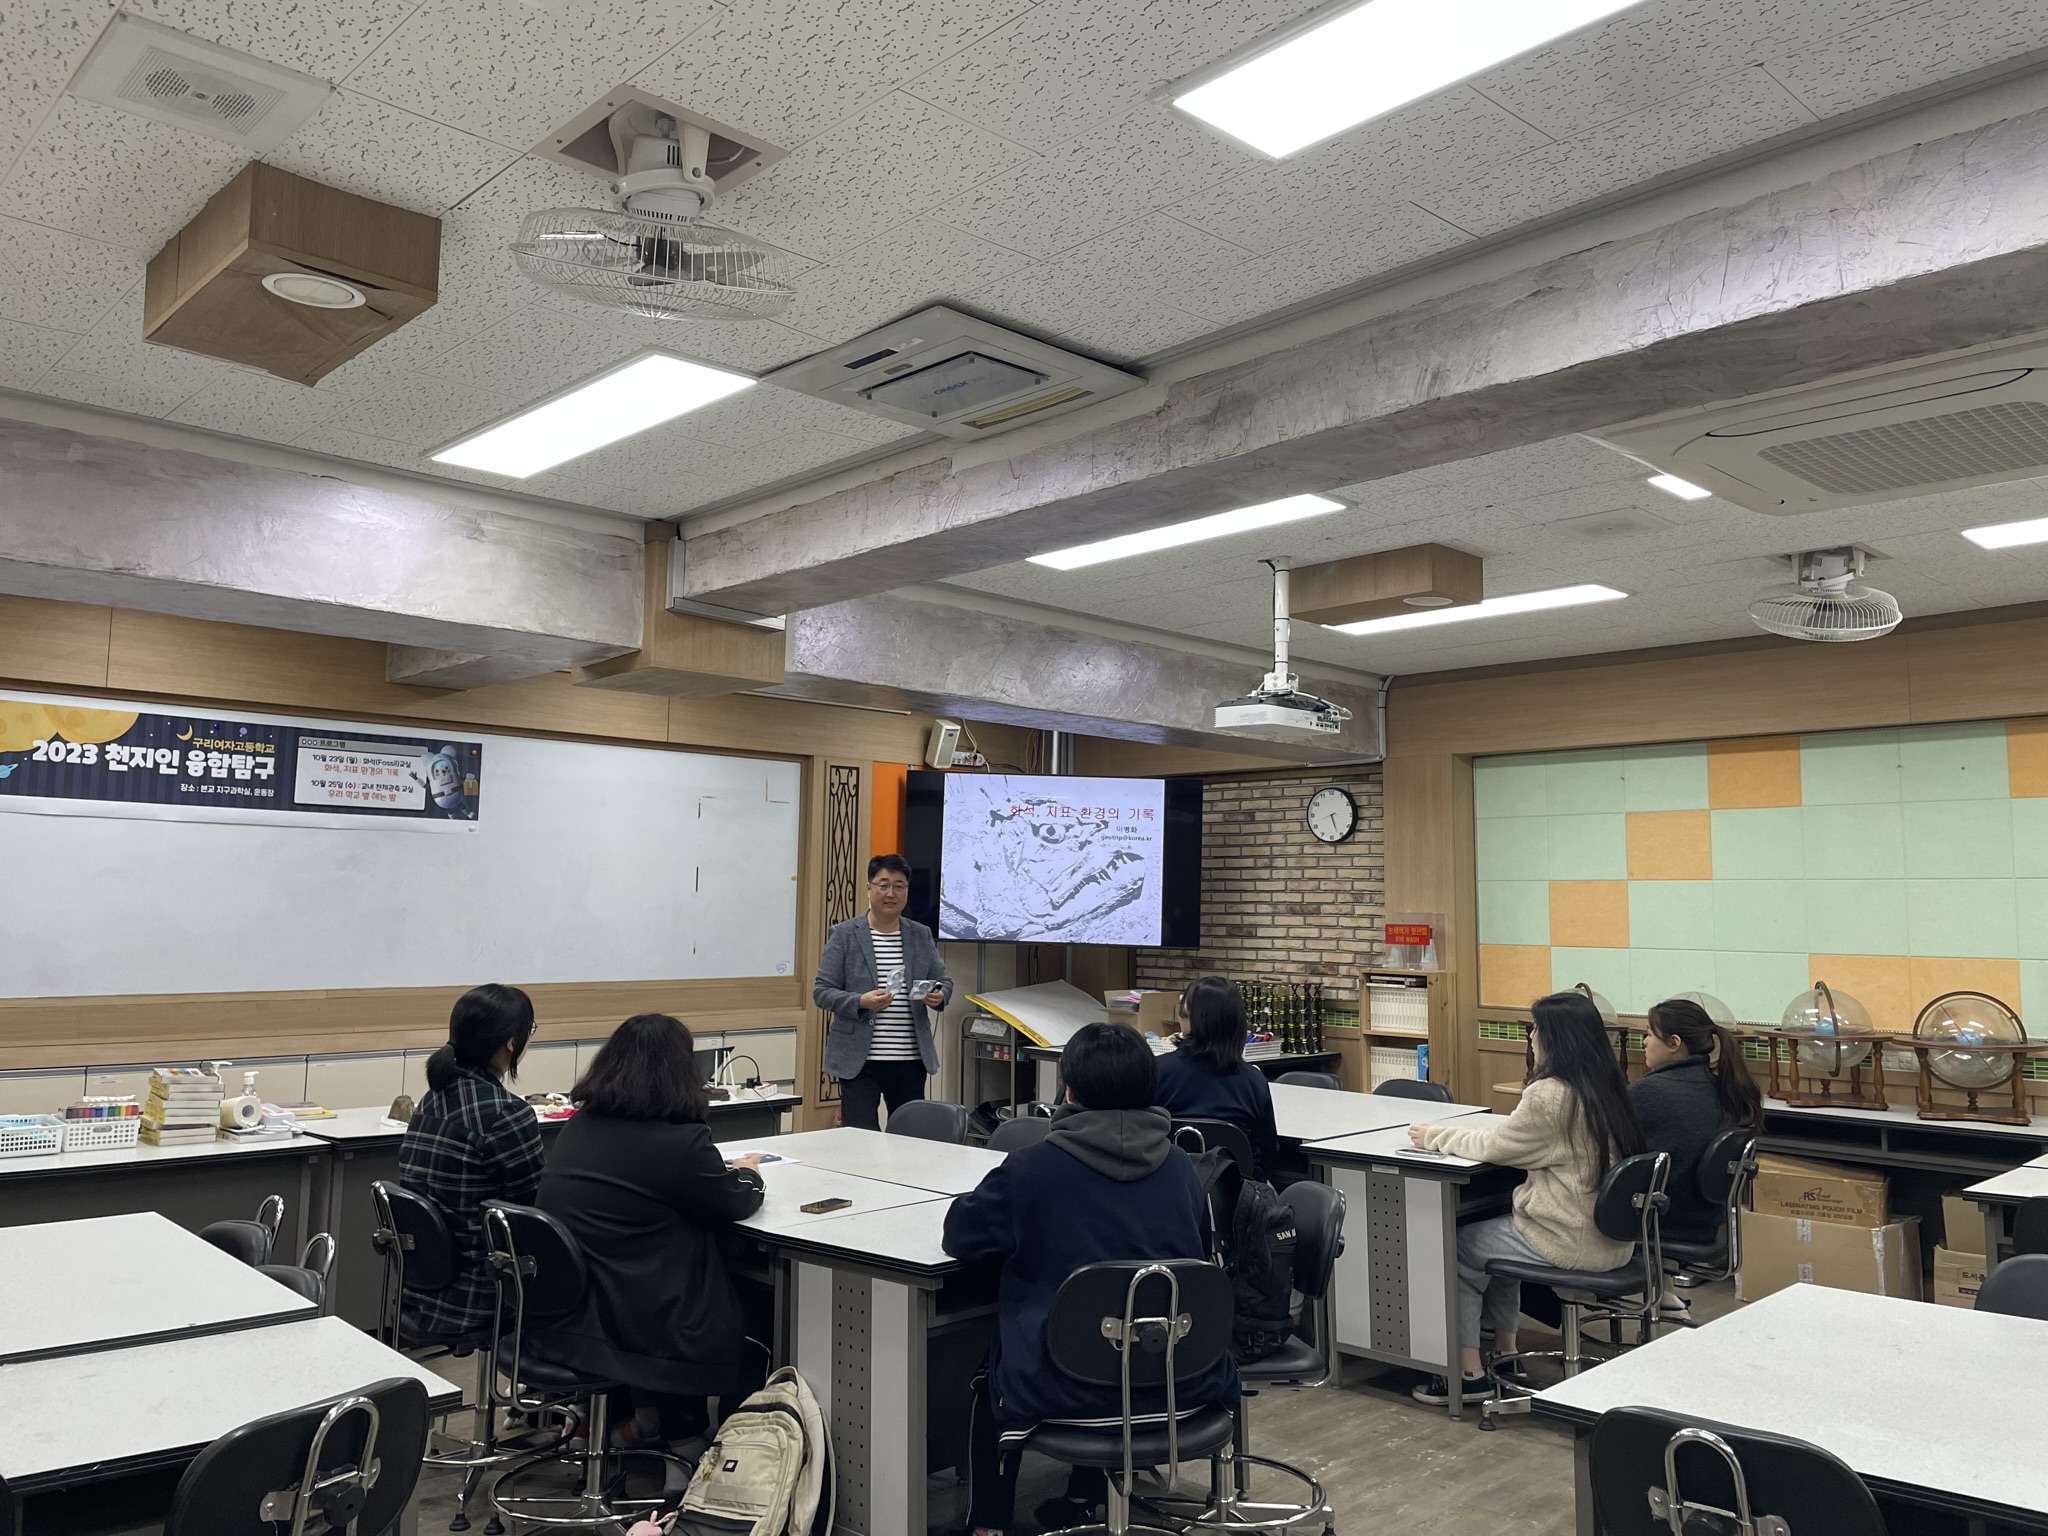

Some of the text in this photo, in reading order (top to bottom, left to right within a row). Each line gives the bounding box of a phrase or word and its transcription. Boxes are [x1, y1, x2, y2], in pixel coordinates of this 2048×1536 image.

[192, 737, 275, 754] 구리여자고등학교
[320, 740, 346, 748] 프로그램
[32, 740, 276, 780] 2023 천지인 융합탐구
[329, 755, 344, 764] 23일
[324, 764, 342, 773] 화석,
[361, 767, 383, 776] 환경의
[180, 783, 195, 792] 장소
[201, 785, 214, 793] 본교
[216, 786, 252, 796] 지구과학실,
[254, 788, 274, 797] 운동장
[328, 790, 343, 798] 우리
[345, 791, 359, 799] 학교
[388, 793, 396, 802] 밤
[1010, 804, 1154, 820] 화석, 지표 환경의 기록
[1803, 1192, 1816, 1201] RS
[1780, 1202, 1820, 1210] LAMINATING
[1276, 1230, 1292, 1240] SAN
